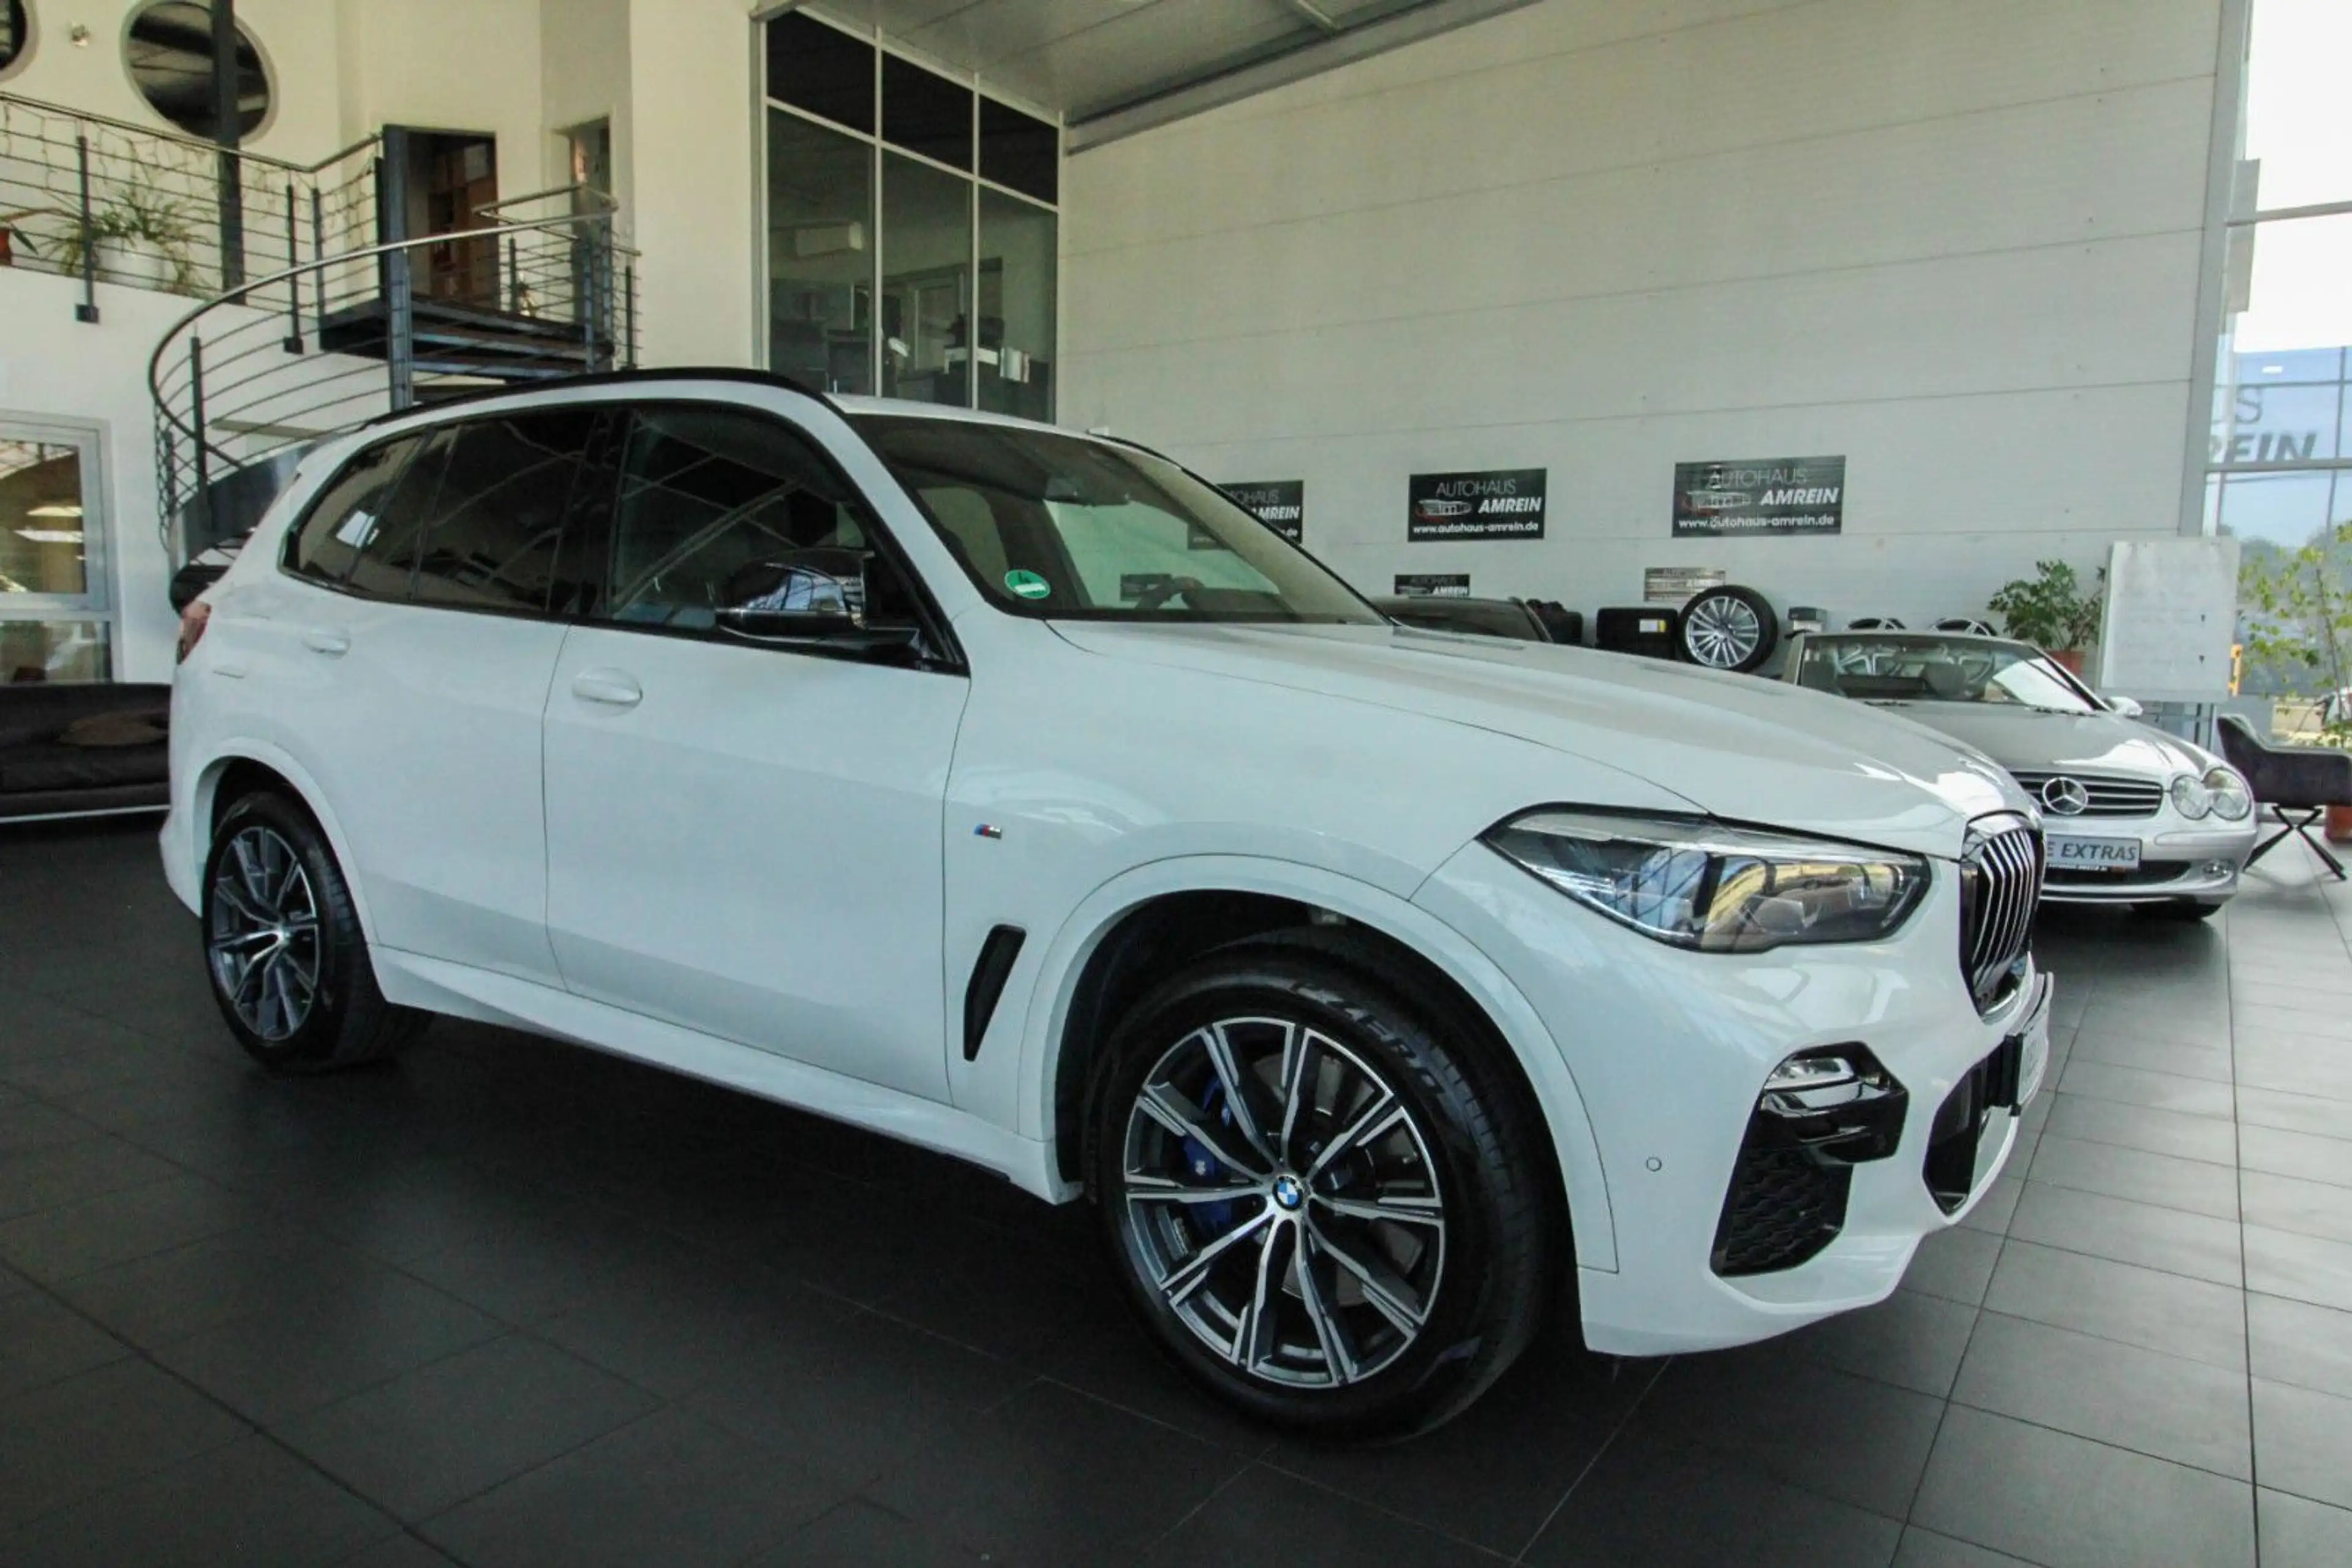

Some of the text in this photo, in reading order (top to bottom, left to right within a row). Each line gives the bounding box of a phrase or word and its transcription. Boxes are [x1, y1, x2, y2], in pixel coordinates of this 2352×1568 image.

[1706, 468, 1807, 489] AUTOHAUS
[1436, 479, 1516, 497] AUTOHAUS
[1760, 488, 1839, 505] AMREIN
[1478, 497, 1542, 513] AMREIN
[1412, 521, 1539, 534] www.autohaus-amrein.de
[1678, 514, 1834, 529] www.autohaus-amrein.de
[2061, 843, 2136, 860] EXTRAS
